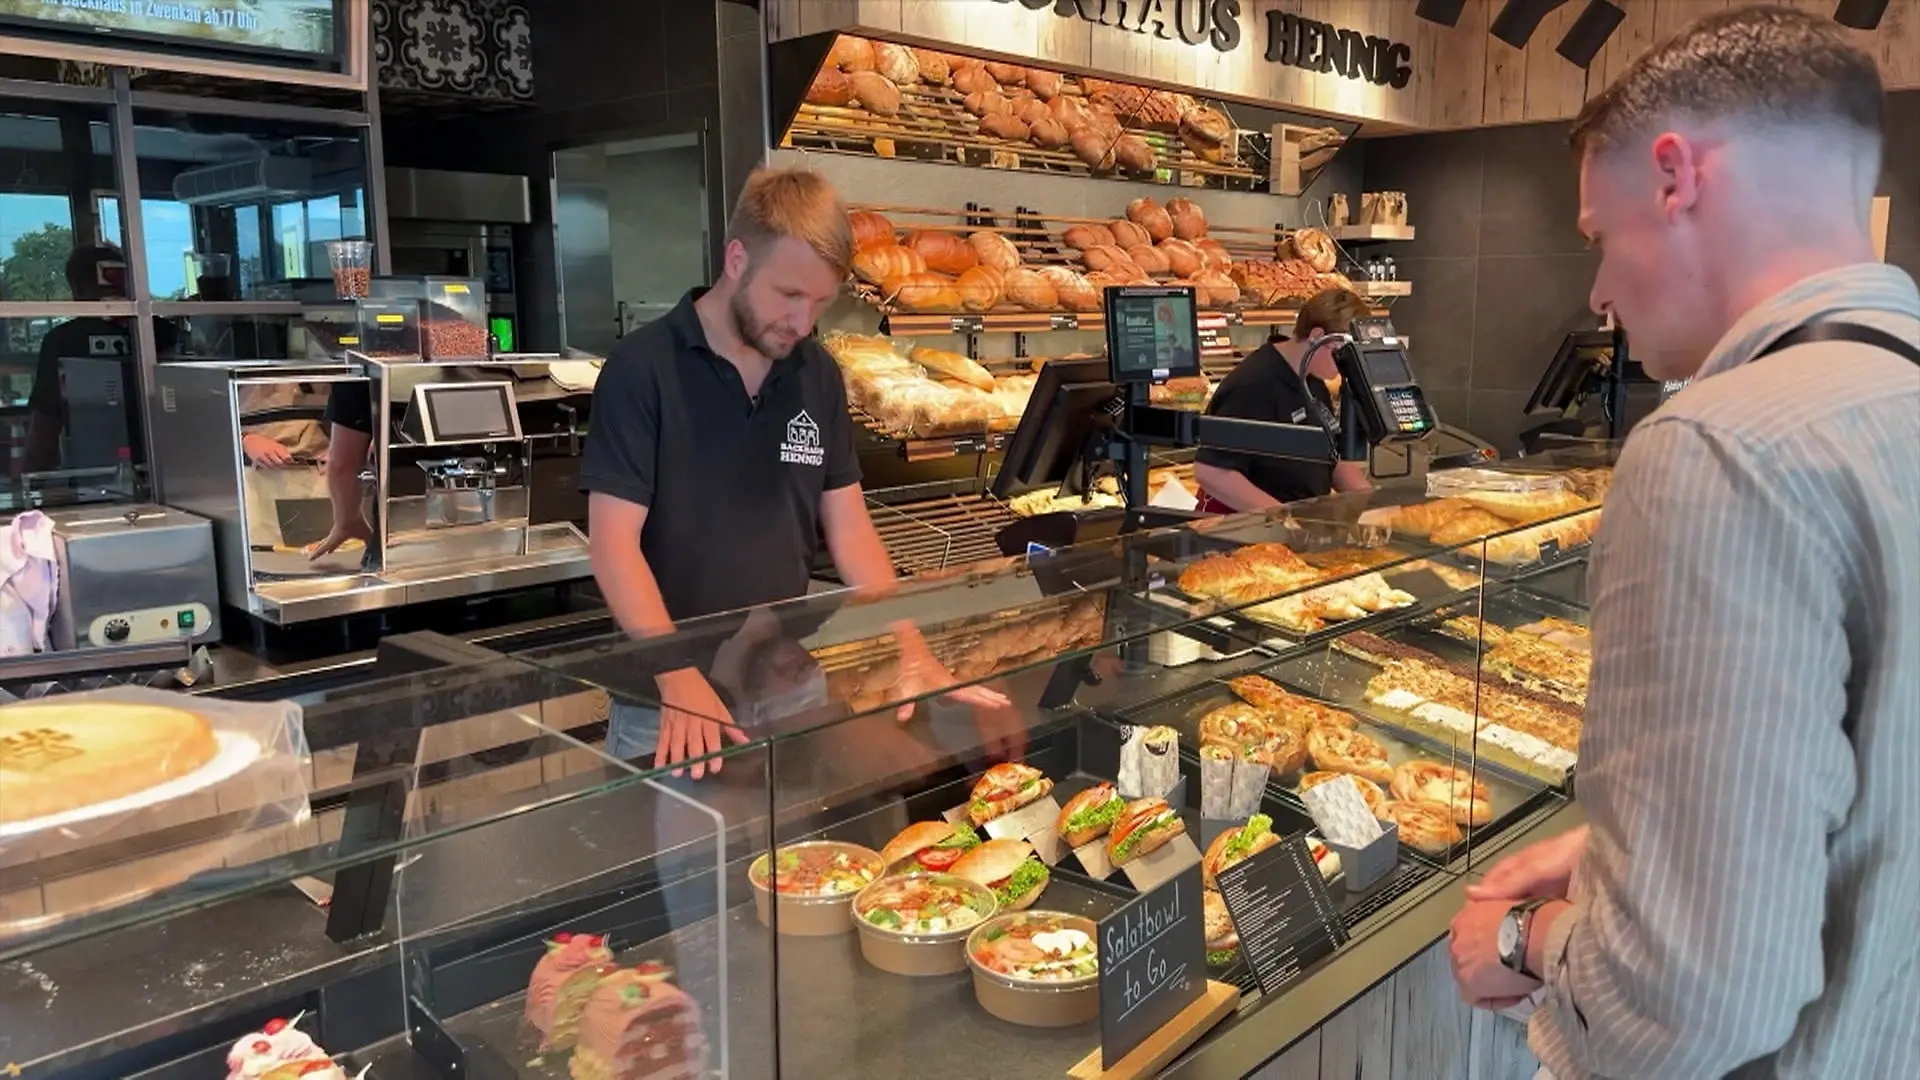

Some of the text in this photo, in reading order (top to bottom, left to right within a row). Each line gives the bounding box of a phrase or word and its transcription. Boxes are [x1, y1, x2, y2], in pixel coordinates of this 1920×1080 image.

[148, 2, 201, 23] Zwenkau
[204, 8, 219, 25] ab
[221, 10, 234, 28] 17
[237, 12, 257, 30] Uhr
[1264, 9, 1412, 90] HENNIG
[1105, 879, 1181, 965] Salatbowl
[1122, 948, 1167, 1008] to Go
